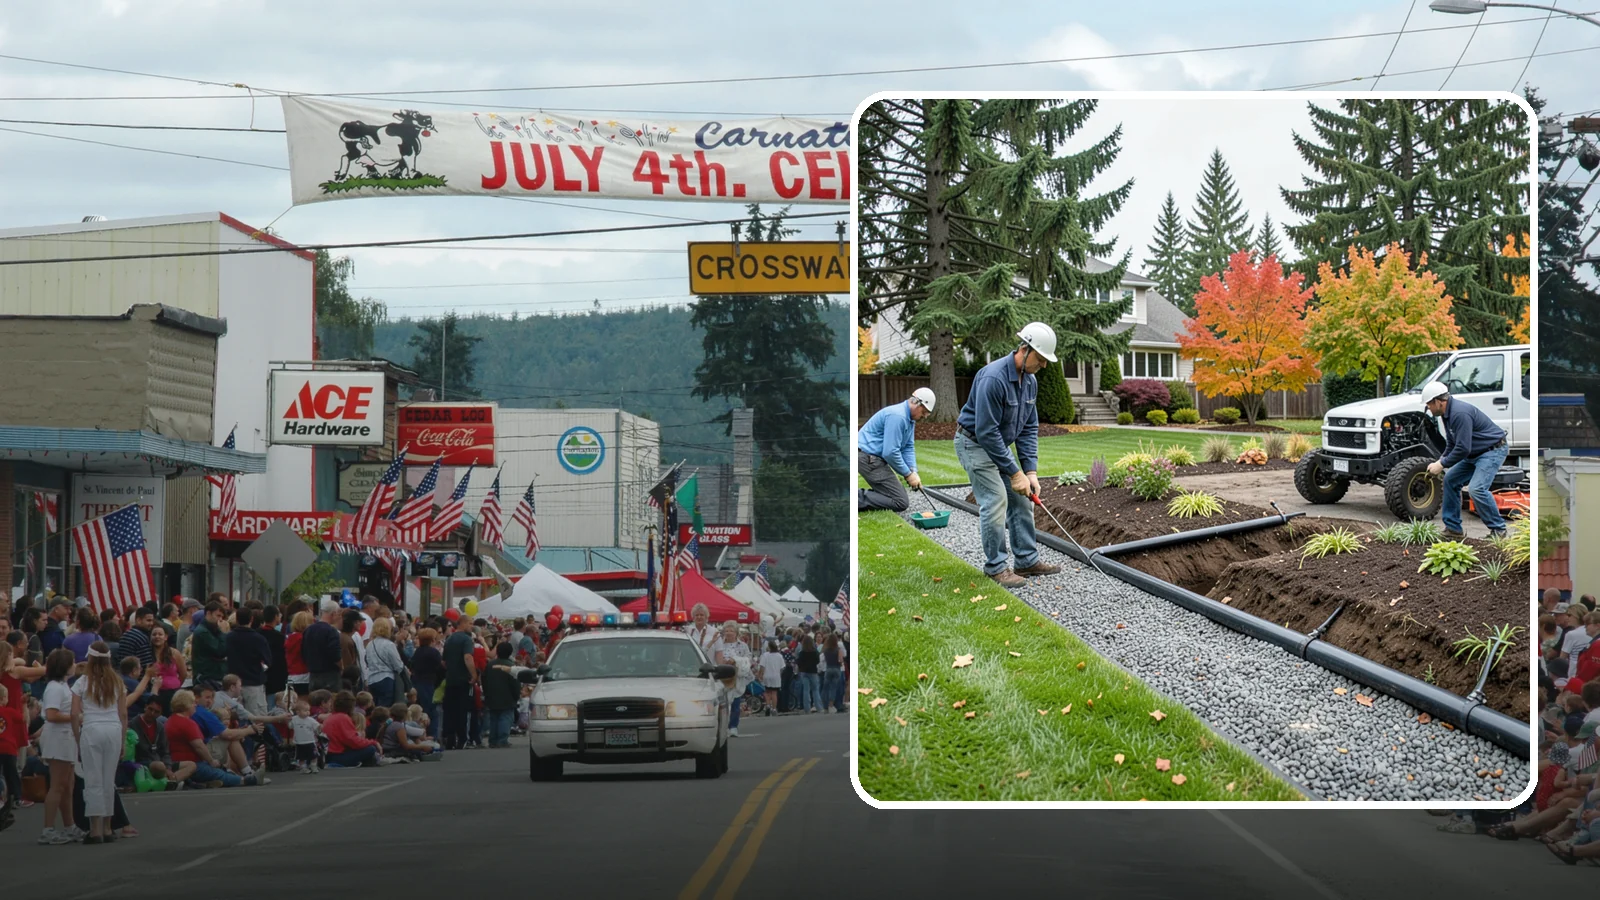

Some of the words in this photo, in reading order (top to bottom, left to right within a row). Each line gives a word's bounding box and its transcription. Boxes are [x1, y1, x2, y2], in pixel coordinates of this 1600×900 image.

[695, 121, 850, 149] Carnat
[481, 141, 604, 192] JULY
[632, 150, 746, 197] 4th.
[697, 254, 850, 280] CROSSWA
[283, 380, 373, 420] ACE
[405, 409, 452, 421] CEDAR
[283, 421, 371, 436] Hardware
[96, 485, 124, 495] Vincent
[126, 486, 136, 495] de
[138, 485, 155, 495] Paul
[81, 503, 153, 522] THT
[688, 527, 741, 535] CRNATION
[699, 535, 730, 543] GLASS
